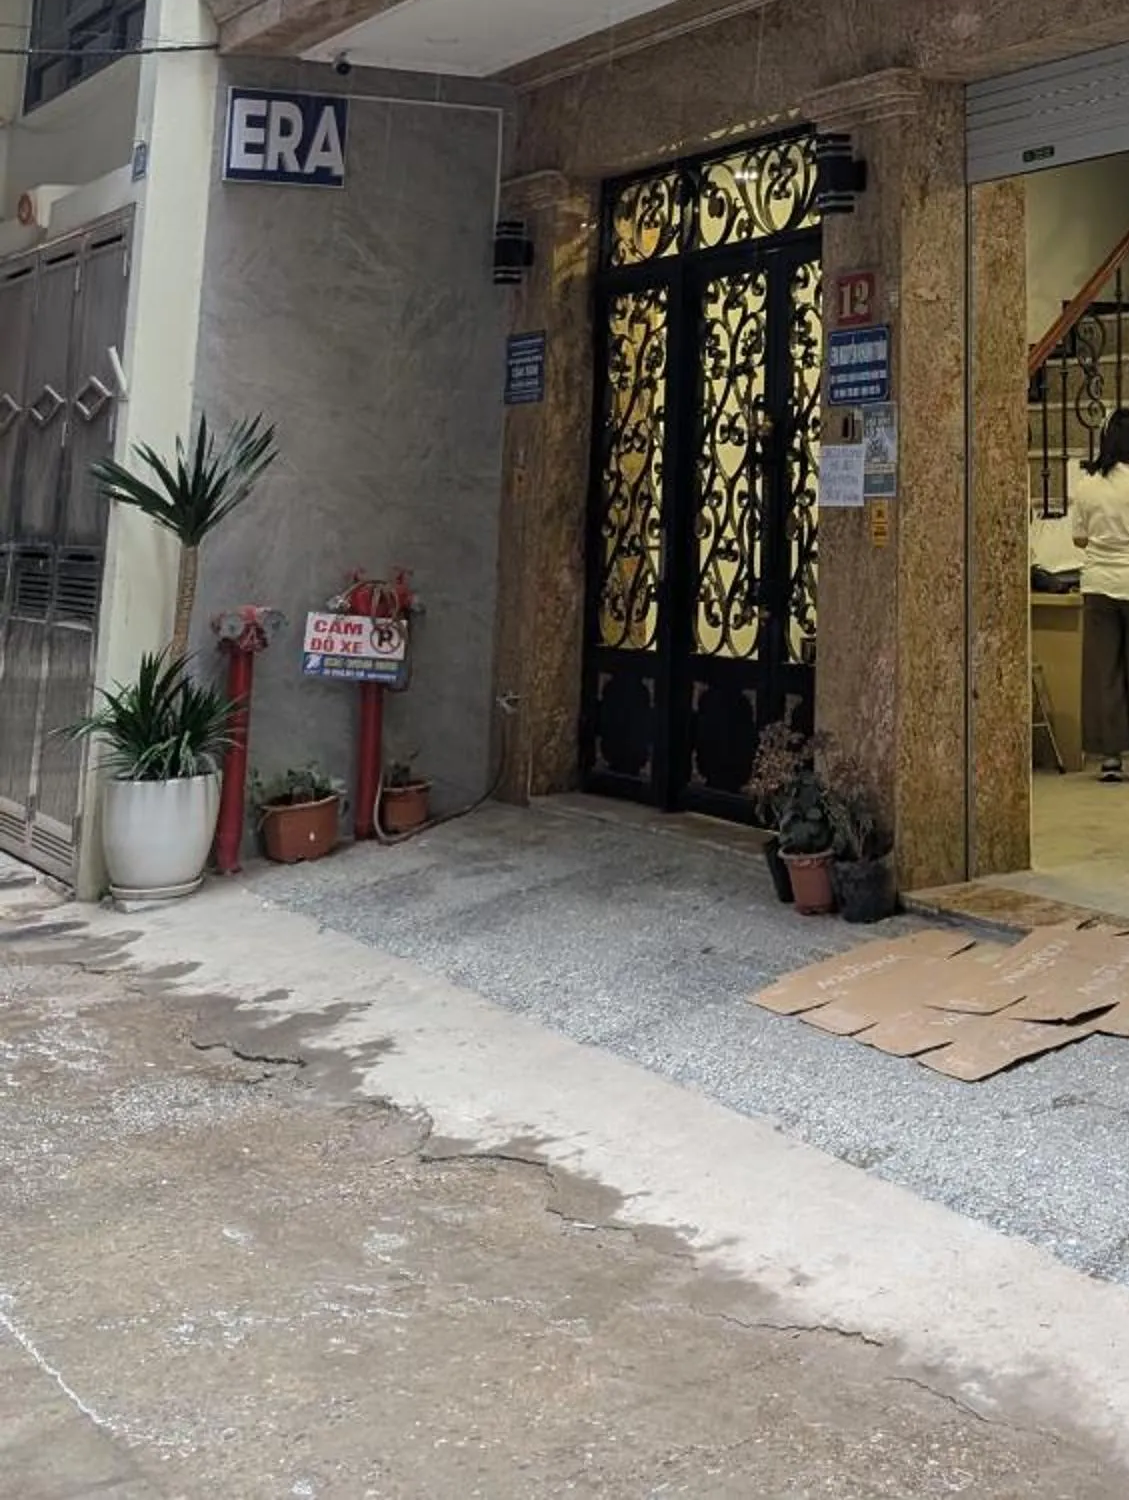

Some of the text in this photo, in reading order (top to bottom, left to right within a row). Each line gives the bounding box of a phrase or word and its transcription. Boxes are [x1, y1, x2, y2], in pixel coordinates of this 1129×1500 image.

[229, 97, 345, 176] ERA
[840, 280, 869, 318] 12
[340, 639, 364, 655] XE
